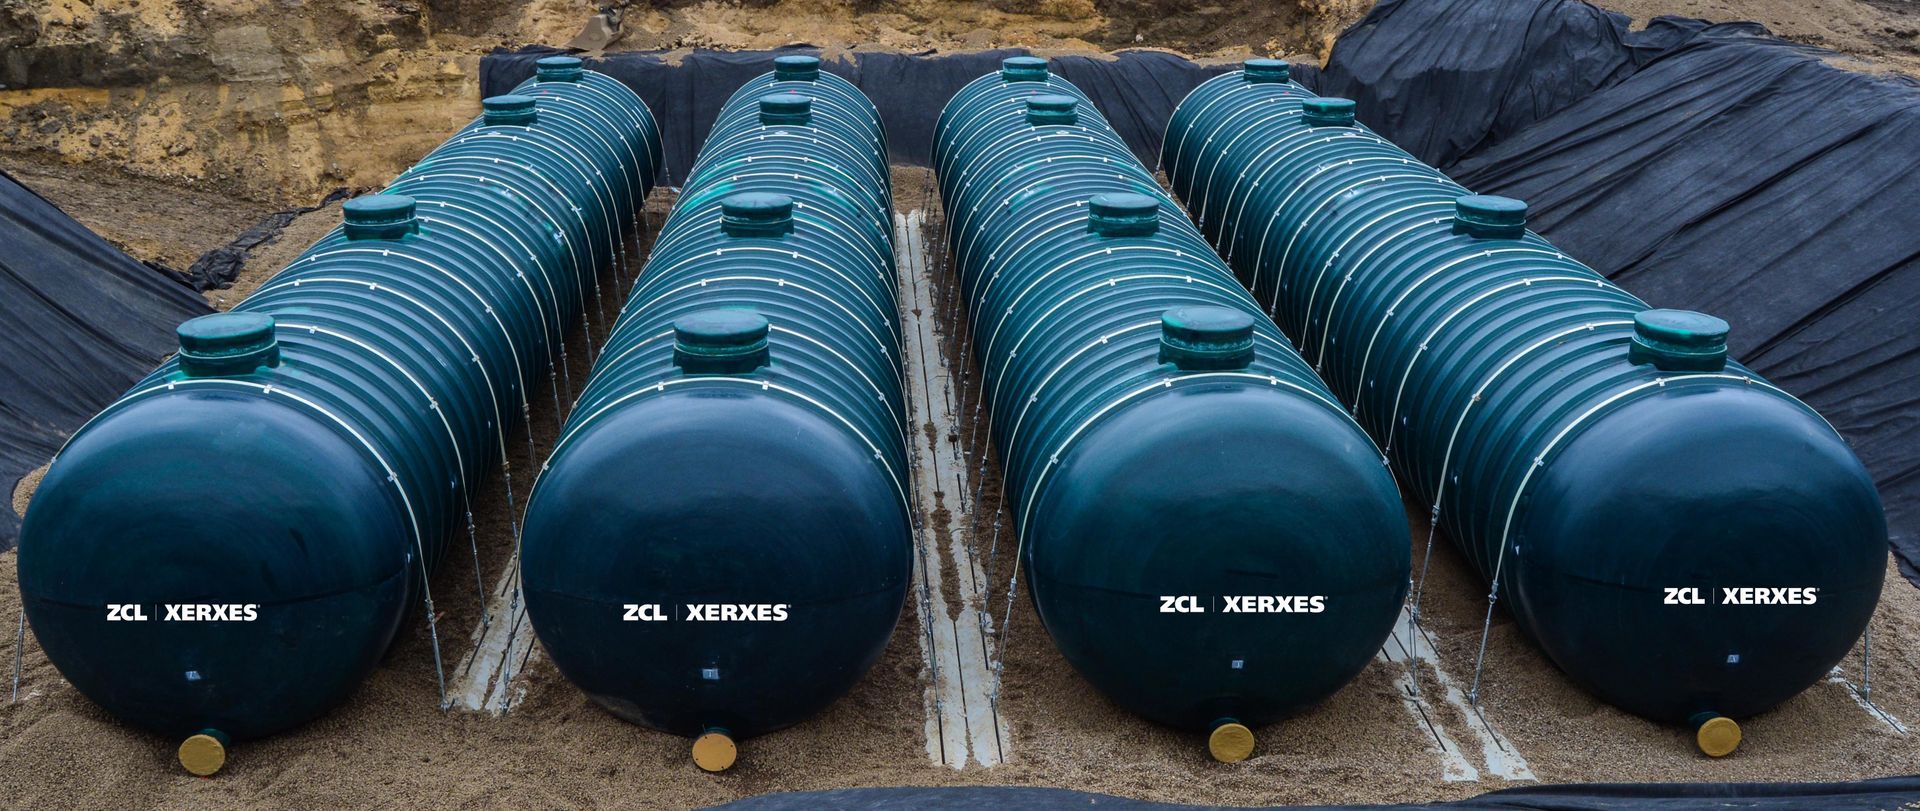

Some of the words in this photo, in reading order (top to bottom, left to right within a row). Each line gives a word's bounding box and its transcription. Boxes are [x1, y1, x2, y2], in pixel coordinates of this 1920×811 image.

[1160, 596, 1205, 612] ZCL
[1223, 596, 1328, 613] XERXES
[1664, 588, 1706, 604] ZCL
[1722, 588, 1820, 605] XERXES
[107, 604, 148, 621] ZCL
[164, 604, 260, 621] XERXES
[623, 604, 668, 621] ZCL
[686, 604, 791, 621] XERXES
